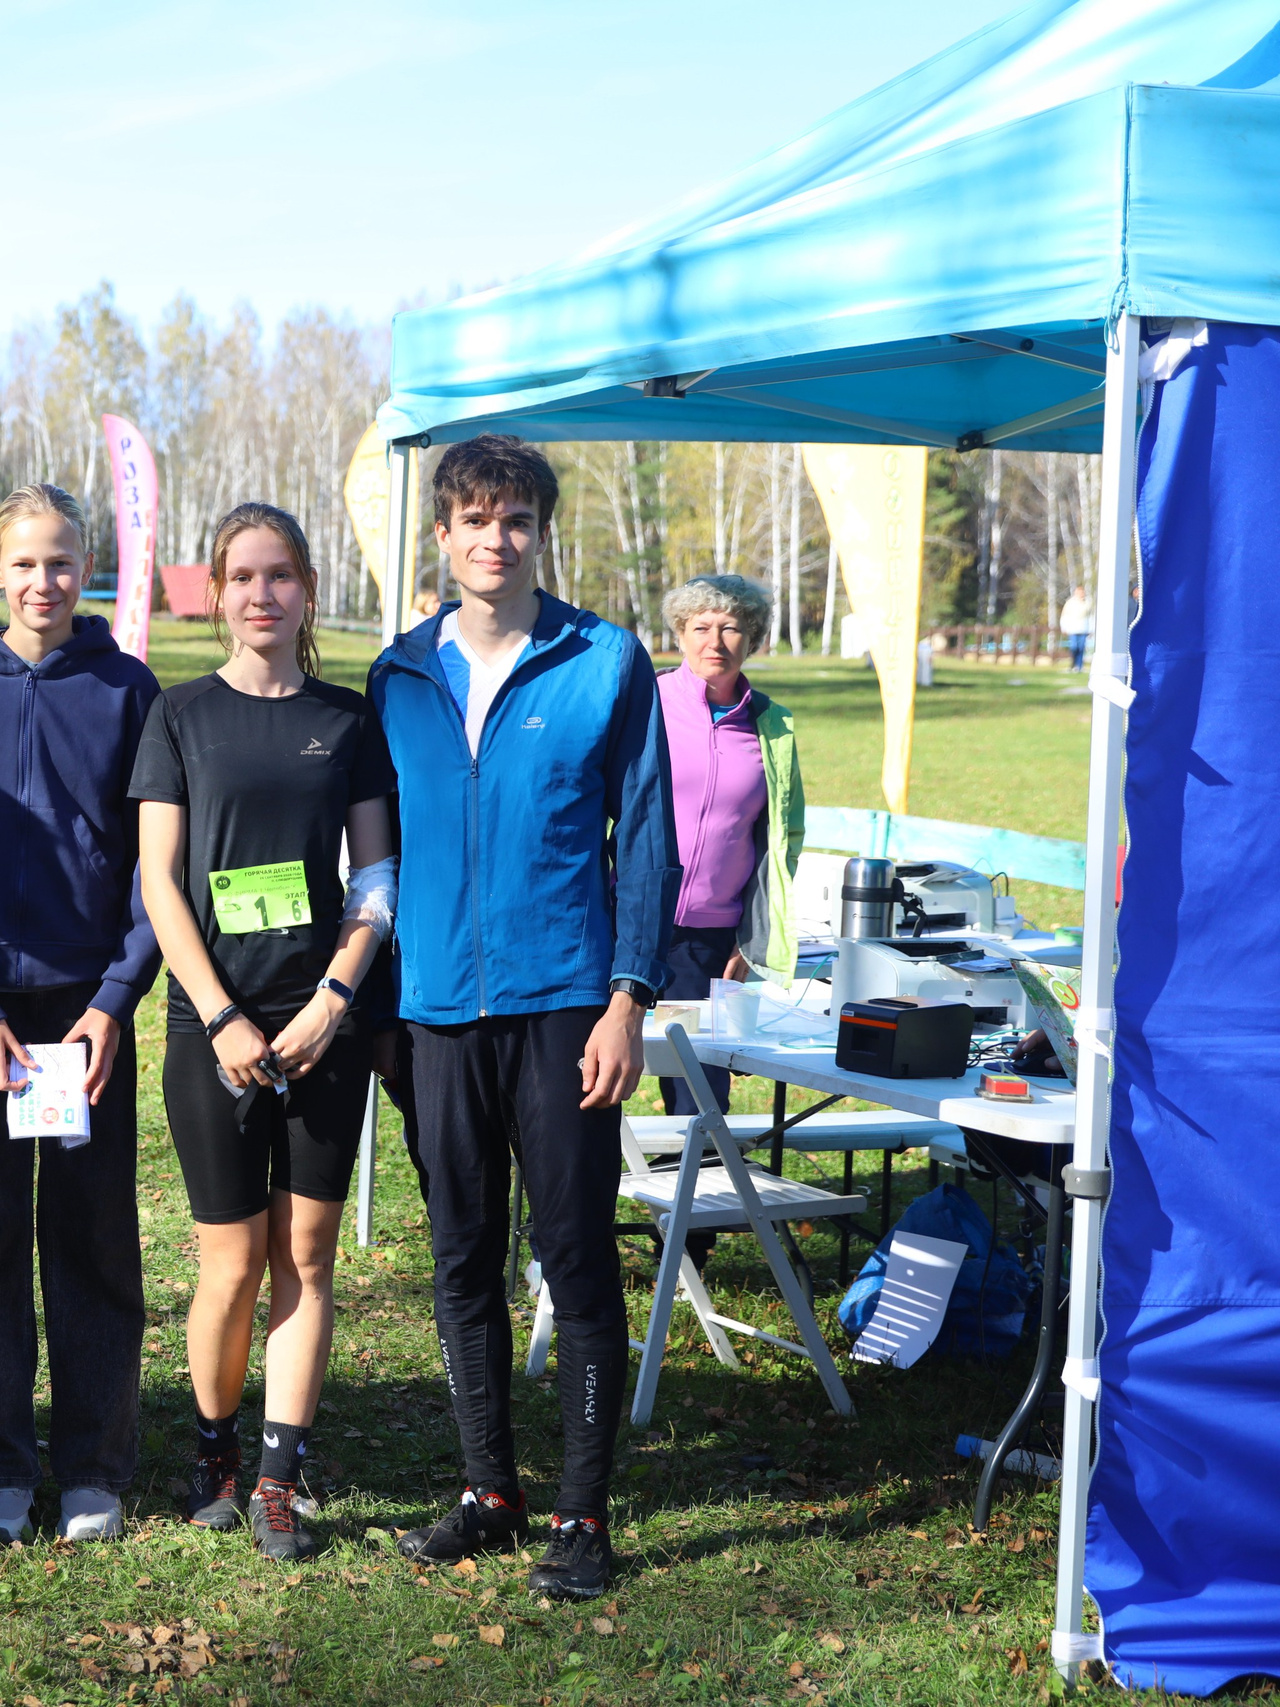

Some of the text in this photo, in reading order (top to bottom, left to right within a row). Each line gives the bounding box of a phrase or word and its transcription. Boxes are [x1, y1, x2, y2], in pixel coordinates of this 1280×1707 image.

[244, 866, 301, 877] ГОРЯЧАЯ ДЕСЯТКА
[285, 891, 306, 899] ЭТАП
[254, 896, 269, 927] 1
[291, 900, 302, 921] 6
